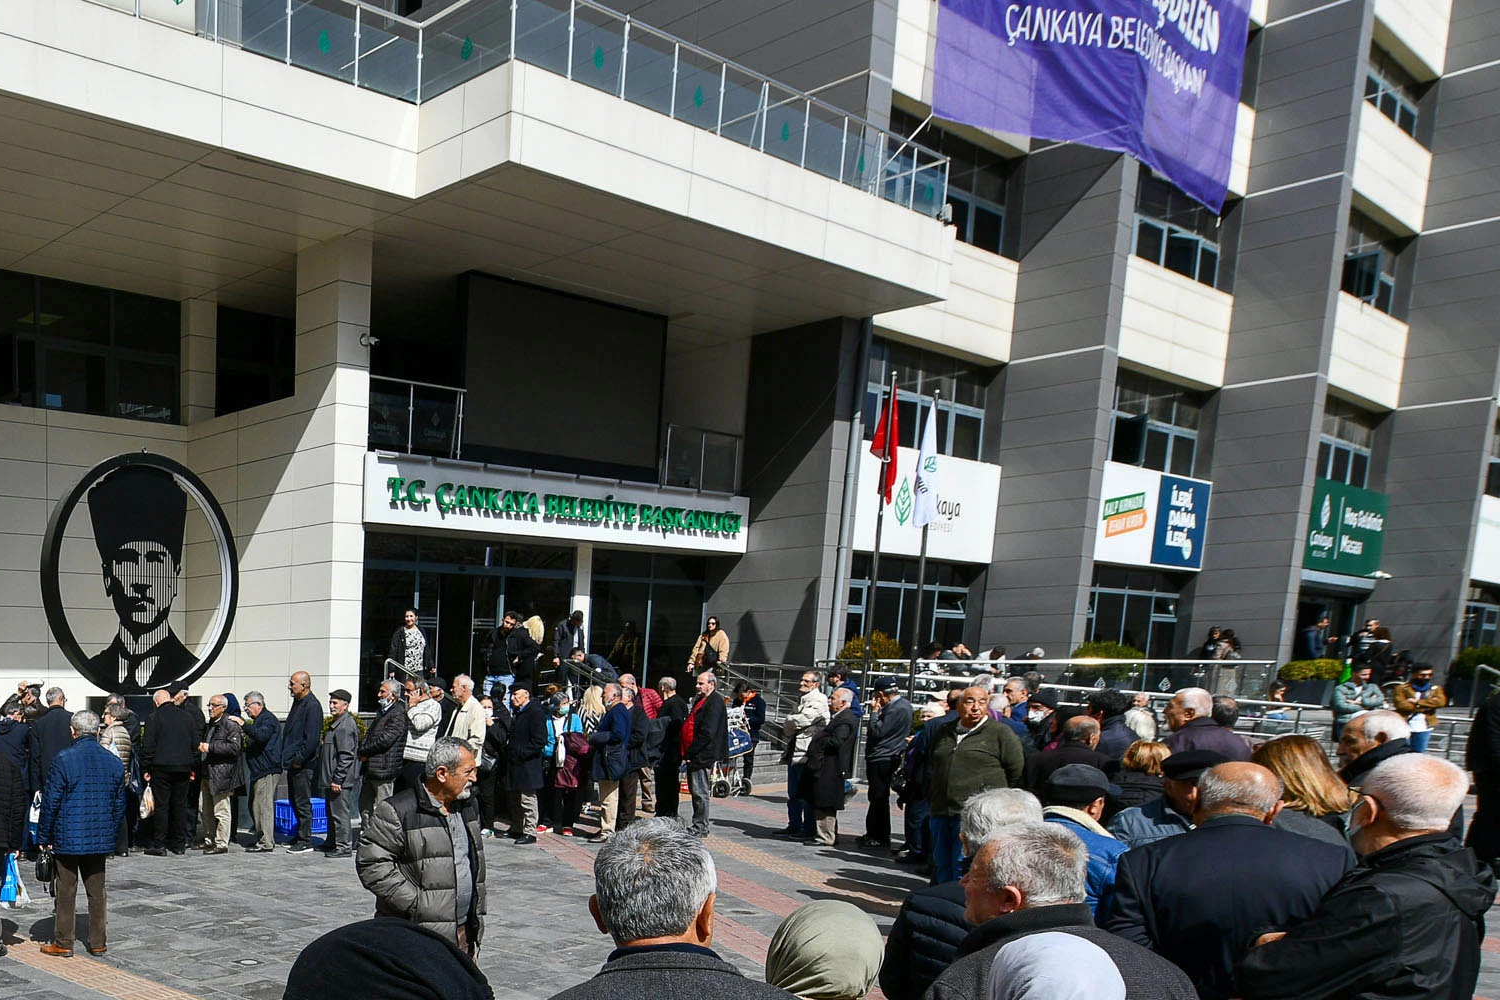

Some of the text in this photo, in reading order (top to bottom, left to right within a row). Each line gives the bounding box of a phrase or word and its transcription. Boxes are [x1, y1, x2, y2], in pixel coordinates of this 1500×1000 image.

[1005, 4, 1104, 46] ÇANKAYA
[1151, 0, 1220, 56] ŞDELEN
[387, 477, 741, 534] T.C. ÇANKAYA BELEDİYE BAŞKANLIĞI
[937, 493, 960, 520] kaya
